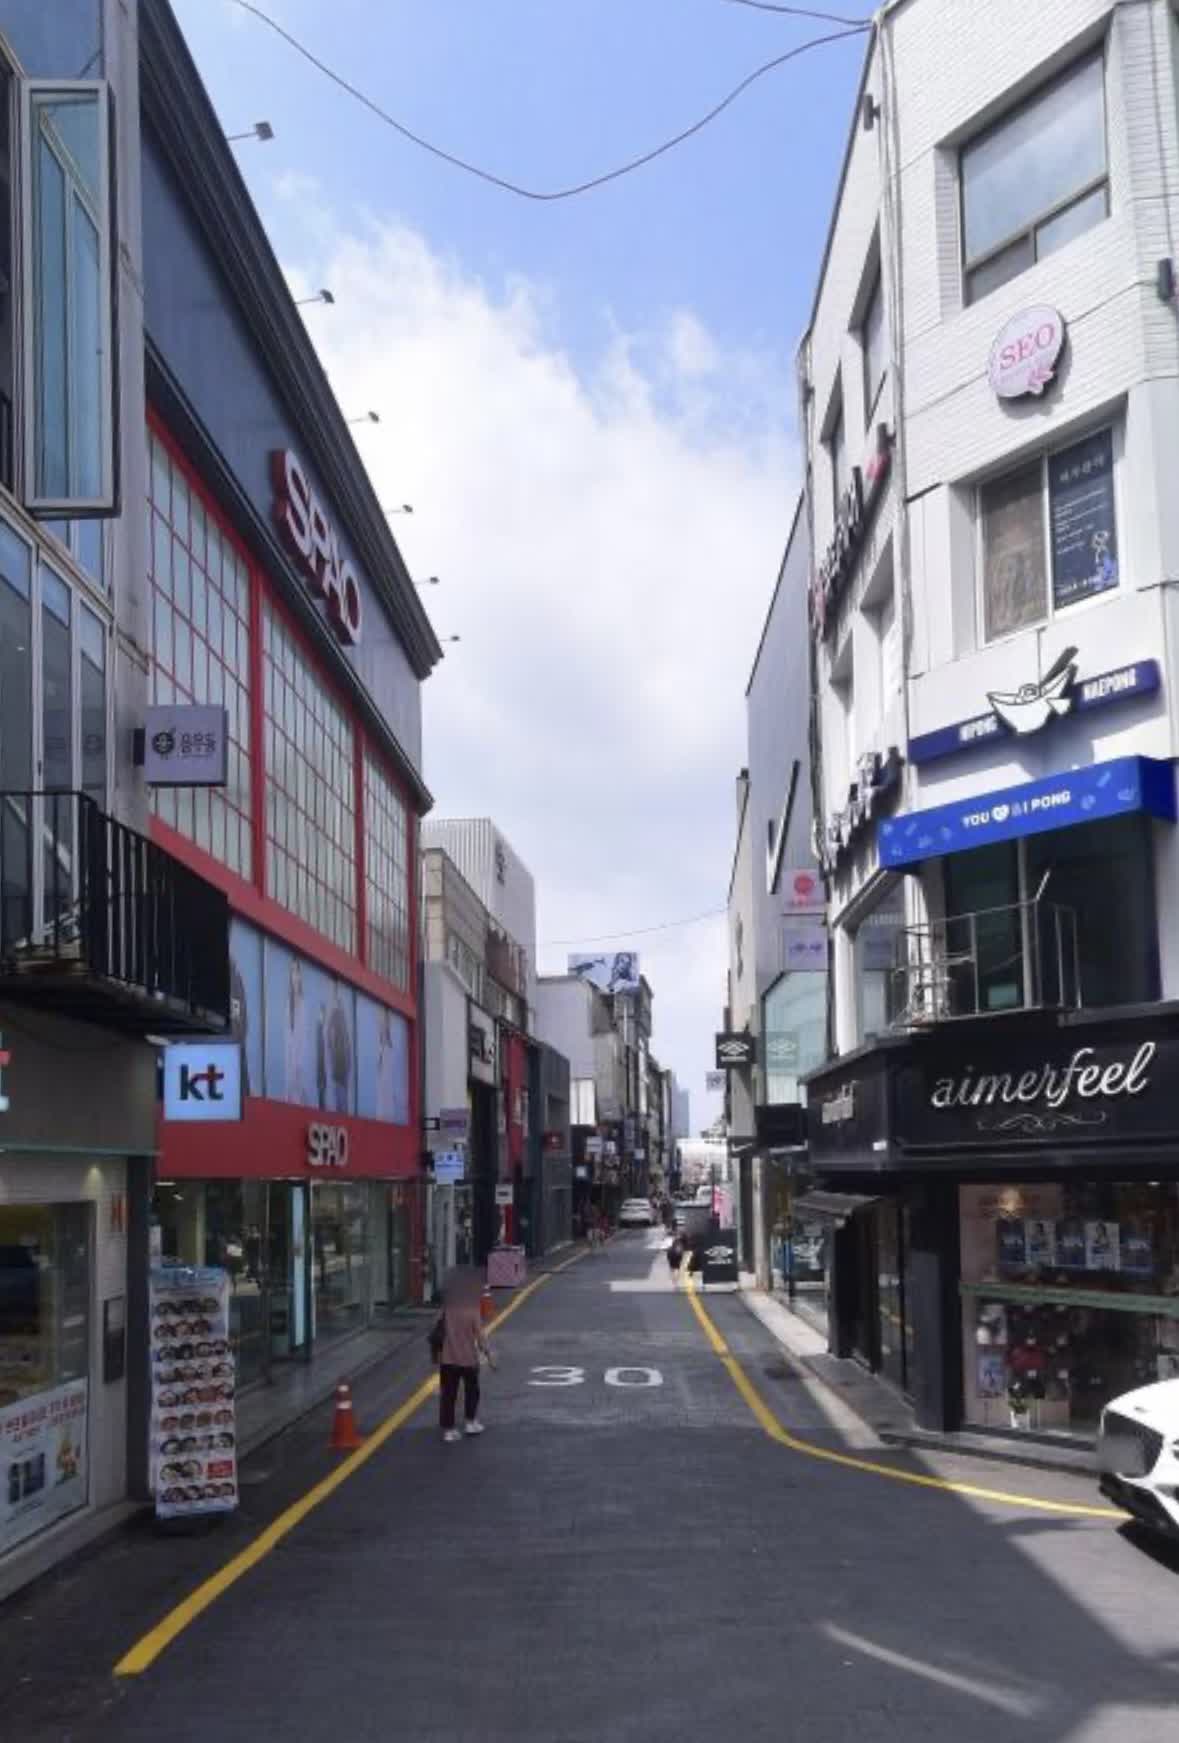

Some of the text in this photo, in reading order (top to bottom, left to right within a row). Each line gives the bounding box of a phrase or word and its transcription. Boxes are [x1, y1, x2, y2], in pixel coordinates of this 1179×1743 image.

[999, 323, 1055, 369] SEO
[962, 812, 990, 828] YOU
[1031, 790, 1072, 811] PONG
[178, 1063, 225, 1101] kt
[931, 1042, 1156, 1108] aimerfeel
[307, 1122, 349, 1167] SPAO
[526, 1365, 664, 1387] 30
